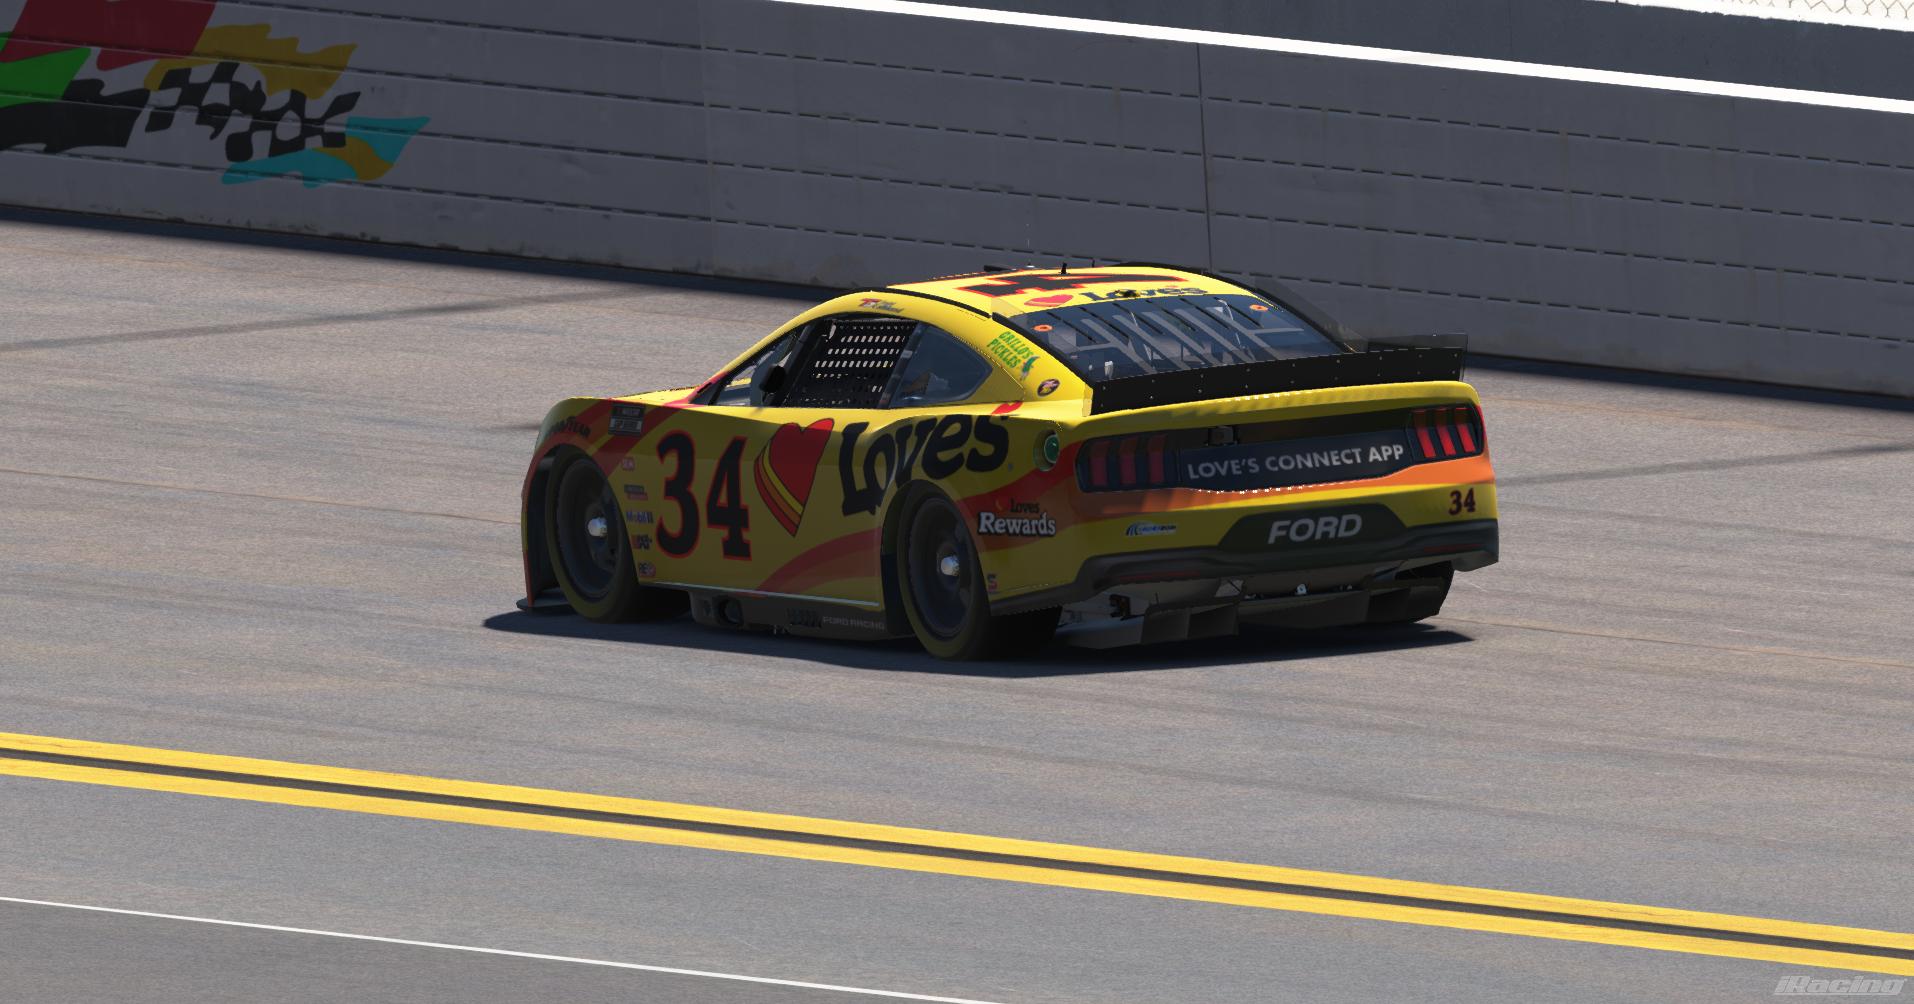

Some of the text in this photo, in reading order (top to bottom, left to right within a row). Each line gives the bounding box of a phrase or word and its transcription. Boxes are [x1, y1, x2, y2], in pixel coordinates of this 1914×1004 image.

[986, 338, 1021, 368] PICKLES
[1187, 444, 1404, 480] LOVE'S CONNECT APP
[655, 429, 752, 561] 34
[1448, 491, 1476, 516] 34
[978, 511, 1056, 537] Rewards
[1267, 513, 1363, 545] FORD
